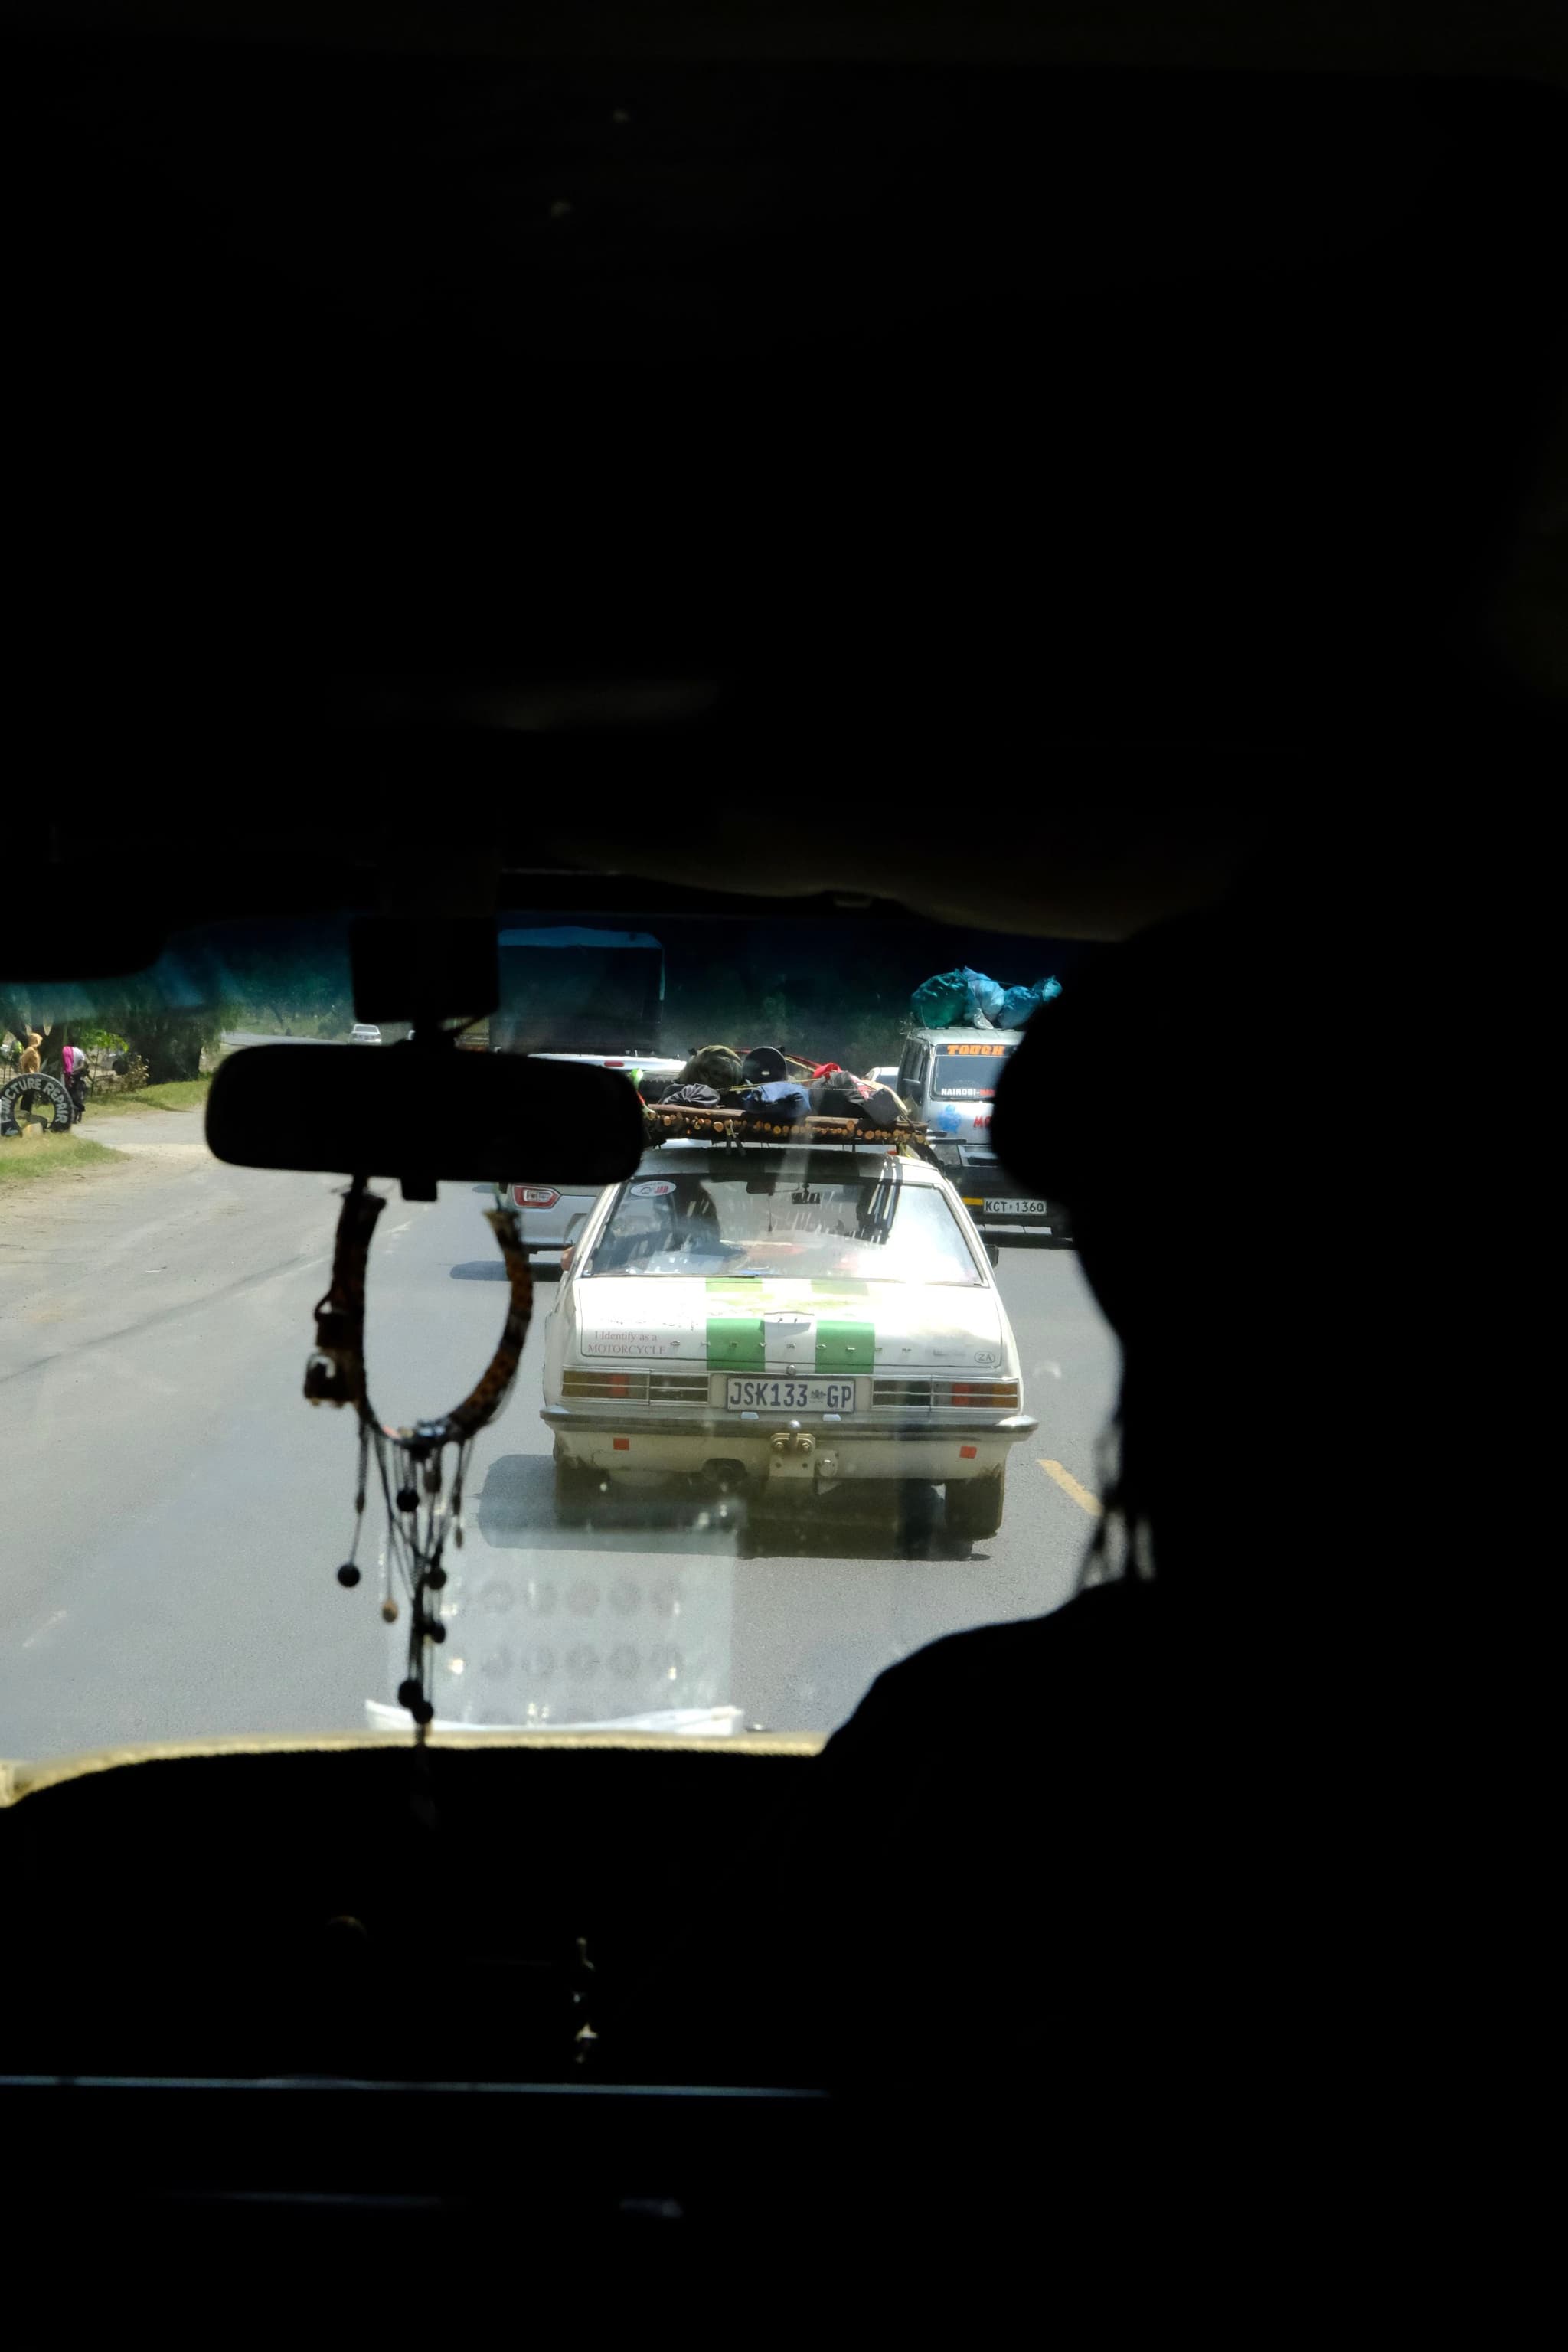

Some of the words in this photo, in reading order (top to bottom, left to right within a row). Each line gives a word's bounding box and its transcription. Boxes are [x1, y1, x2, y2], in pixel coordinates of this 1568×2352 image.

[947, 1044, 1005, 1056] TOUGH
[43, 1082, 68, 1123] REPAIR
[601, 1331, 637, 1342] Identify
[587, 1344, 666, 1354] MOTORCYCLE
[730, 1382, 808, 1408] JSK133
[826, 1385, 851, 1409] GP
